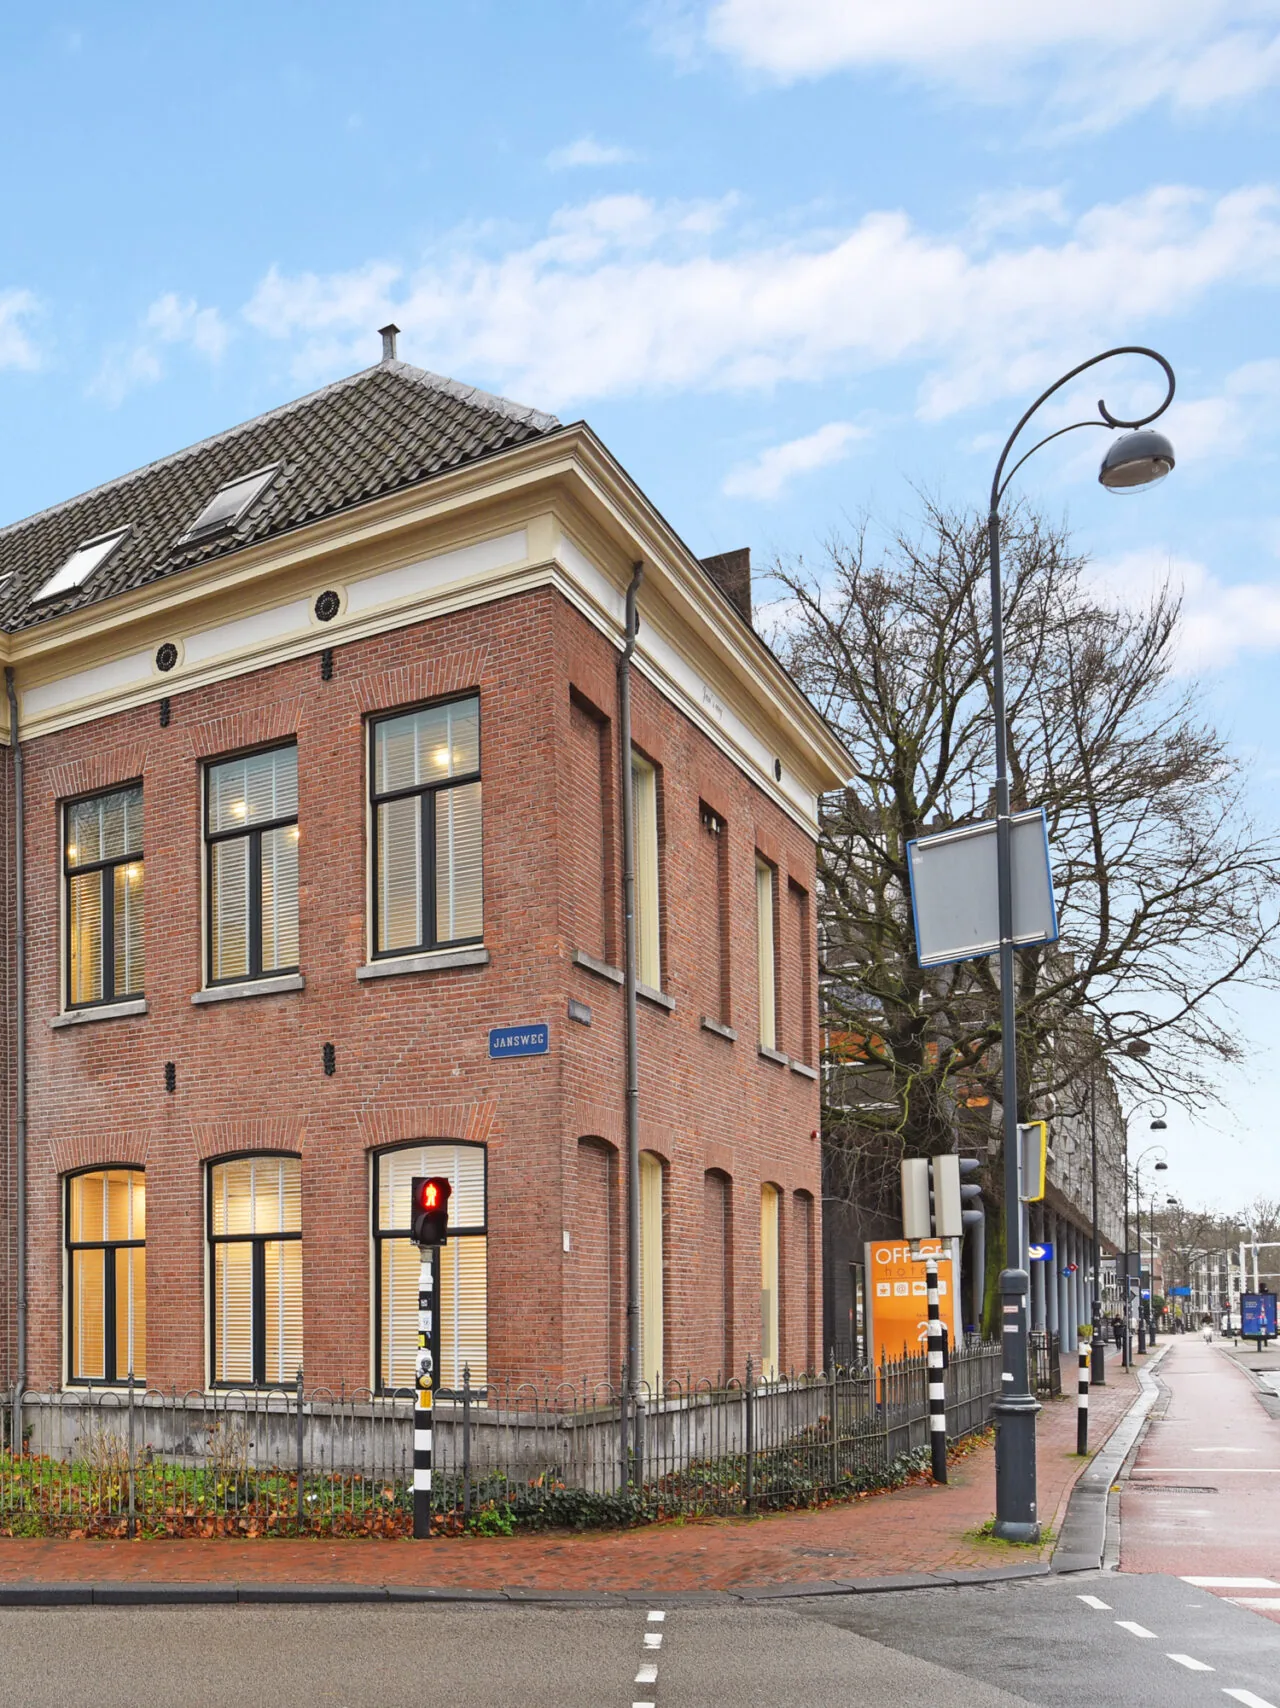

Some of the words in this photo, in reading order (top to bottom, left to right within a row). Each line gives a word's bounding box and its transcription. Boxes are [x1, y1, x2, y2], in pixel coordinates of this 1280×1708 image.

[493, 1033, 544, 1049] JANSWEG
[875, 1246, 945, 1265] OFFCE
[885, 1264, 927, 1277] hote
